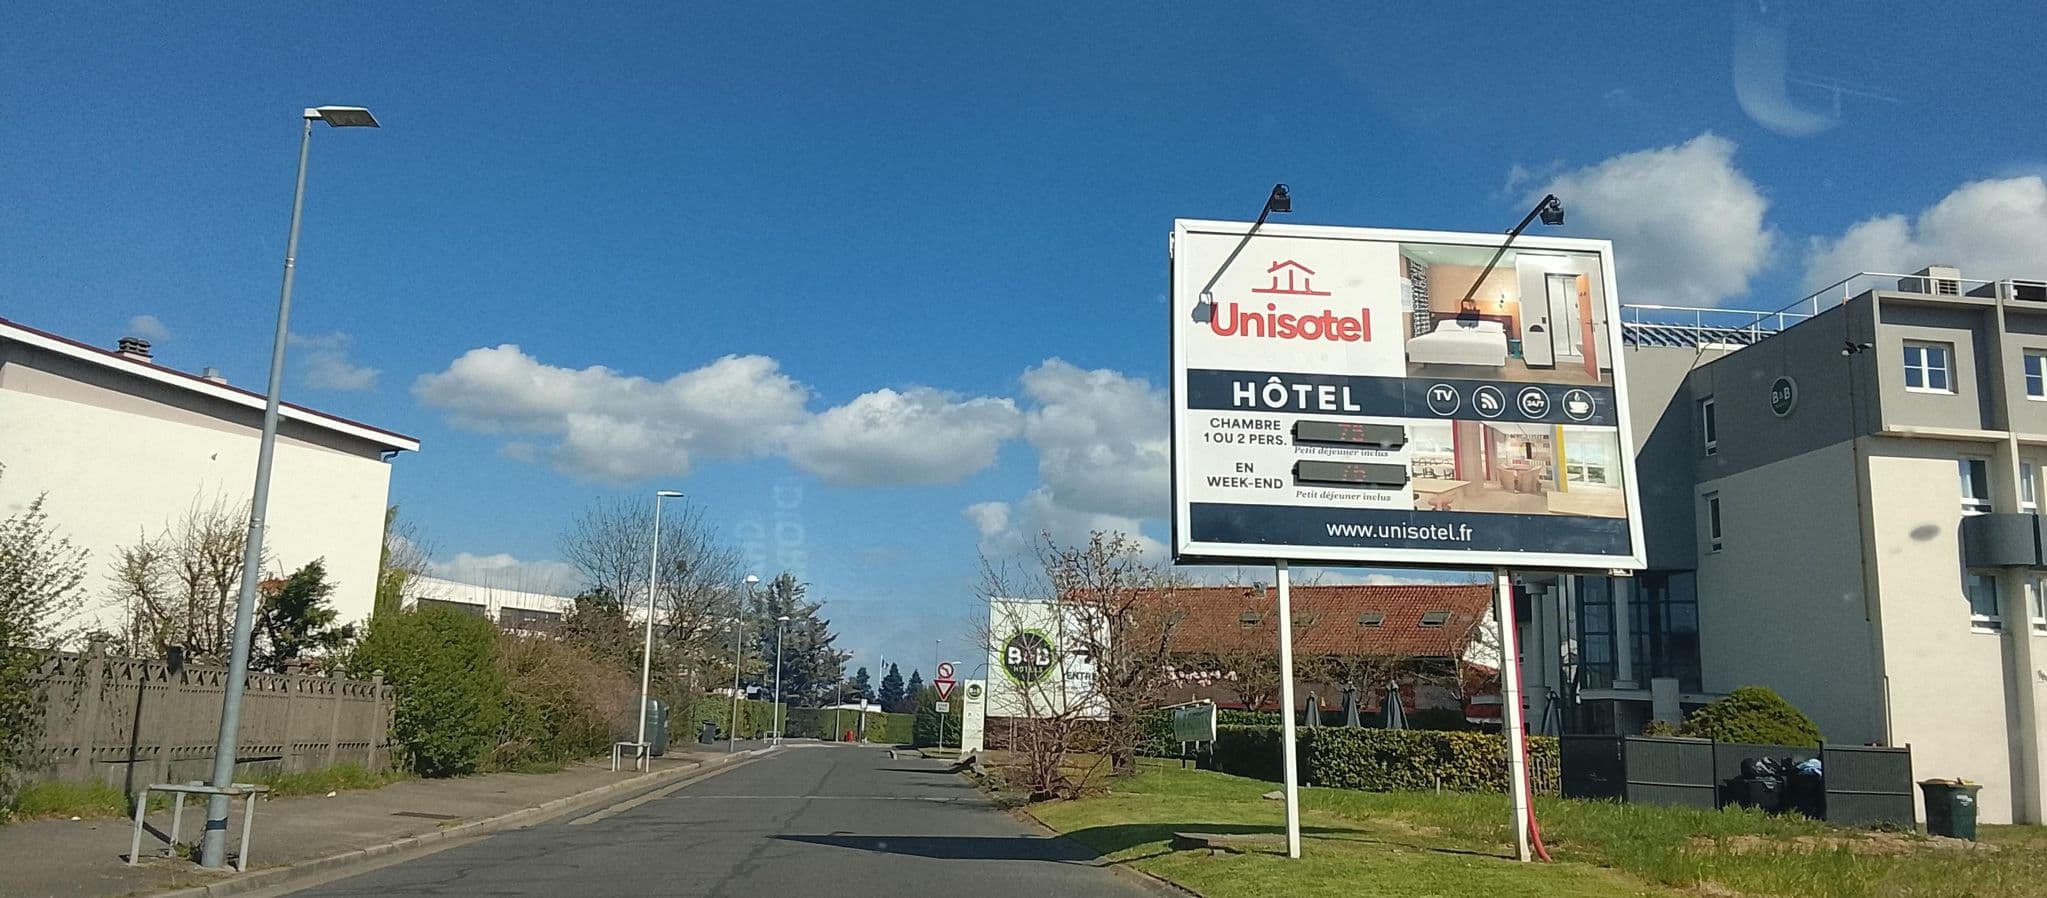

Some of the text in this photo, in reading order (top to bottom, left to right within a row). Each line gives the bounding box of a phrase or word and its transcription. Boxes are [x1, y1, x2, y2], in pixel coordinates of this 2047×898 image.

[1211, 302, 1372, 342] Unisotel
[1232, 376, 1361, 412] HÔTEL
[1434, 389, 1452, 401] TV
[1210, 417, 1281, 431] CHAMBRE
[1204, 433, 1287, 446] 1 OU 2 PERS.
[1294, 446, 1316, 454] Petit
[1235, 462, 1254, 473] EN
[1207, 476, 1283, 489] WEEK-END
[1296, 490, 1318, 498] Petit
[1363, 493, 1391, 502] inclus
[1326, 522, 1473, 541] www.unisotel.fr
